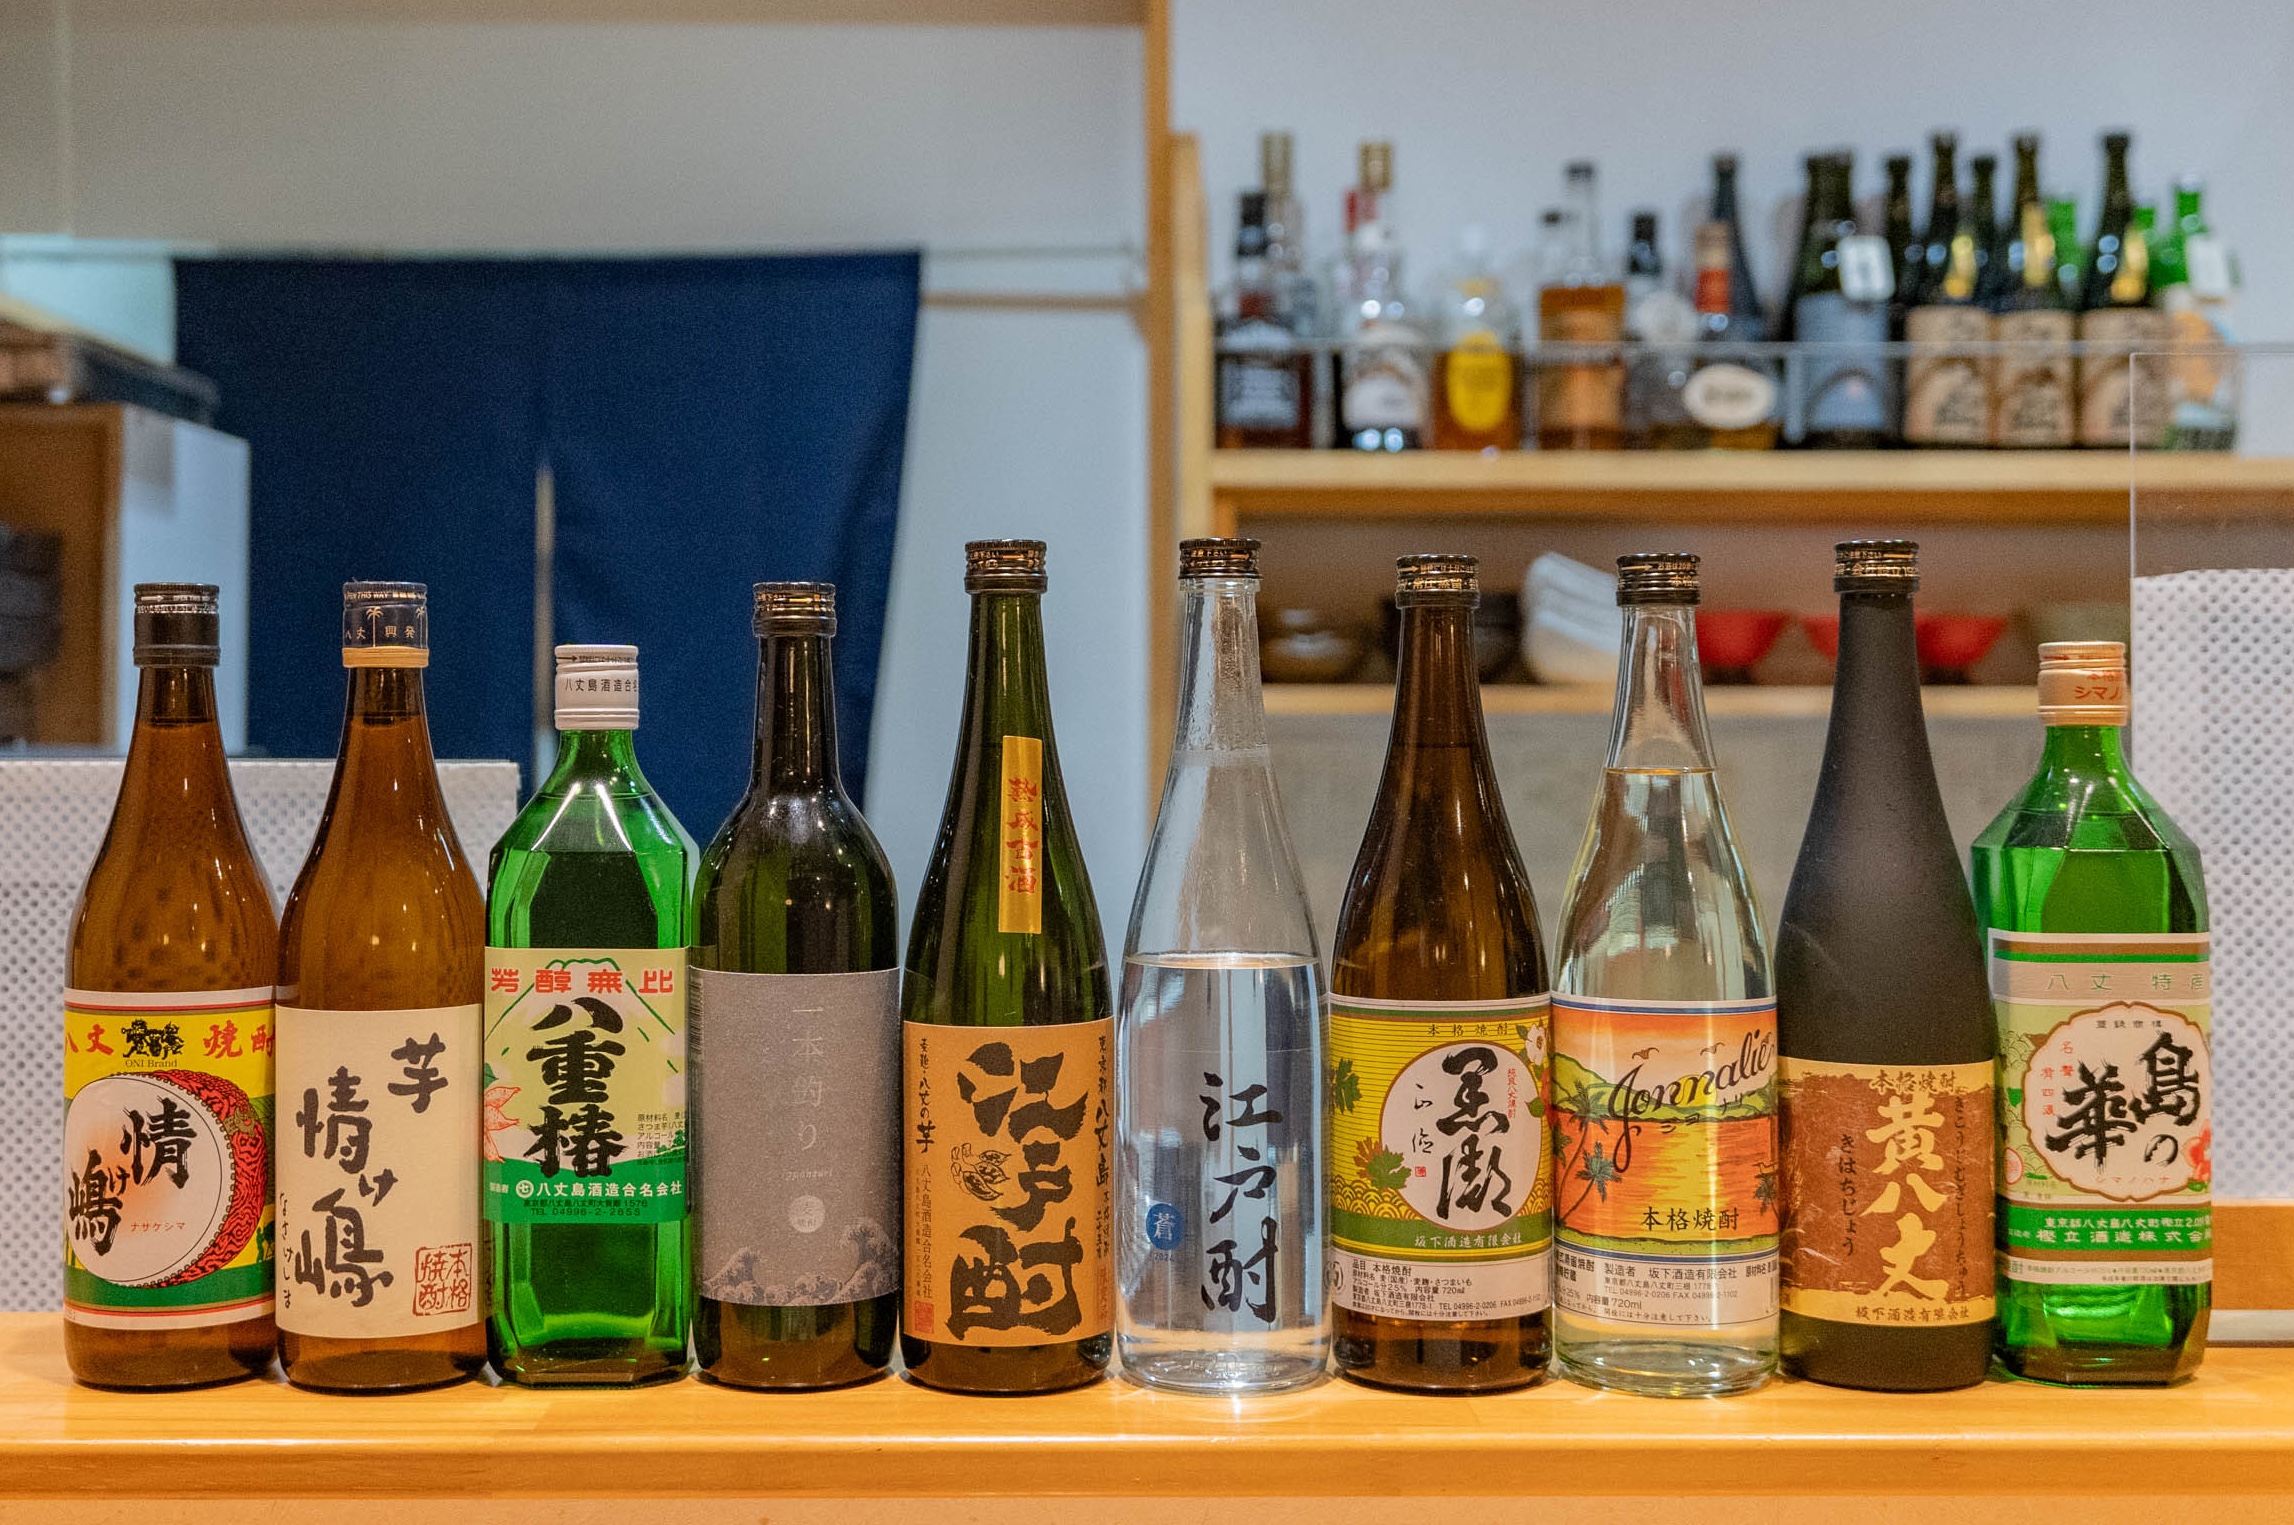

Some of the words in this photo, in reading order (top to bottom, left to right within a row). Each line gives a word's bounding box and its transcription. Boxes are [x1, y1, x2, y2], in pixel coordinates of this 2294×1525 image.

[1005, 777, 1039, 894] 熟成古酒
[490, 967, 674, 994] 芳醇無比
[125, 1059, 145, 1068] ONI
[148, 1059, 178, 1068] Brand
[387, 1032, 448, 1113] 芋
[522, 996, 627, 1178] 八重椿
[1870, 1069, 1958, 1094] 本格焼酎
[536, 1181, 683, 1197] 八丈島酒造合名会社
[1838, 1134, 1857, 1256] きはちじょう
[1858, 1092, 1950, 1301] 黄八丈
[531, 1208, 547, 1216] TEL
[1641, 1206, 1740, 1232] 本格焼酎
[131, 1222, 186, 1232] ナサケシマ
[921, 1164, 932, 1299] 八丈島酒造合名会社
[1153, 1212, 1175, 1241] 蒼
[1414, 1234, 1523, 1249] 坂下酒造有限会社
[1352, 1259, 1366, 1270] 品目
[1372, 1263, 1412, 1277] 本格焼酎
[1604, 1262, 1636, 1278] 製造者
[1649, 1267, 1738, 1281] 坂下酒造有限会社
[1605, 1286, 1617, 1294] TEL
[1673, 1291, 1690, 1299] FAX
[1611, 1298, 1642, 1309] 720ml
